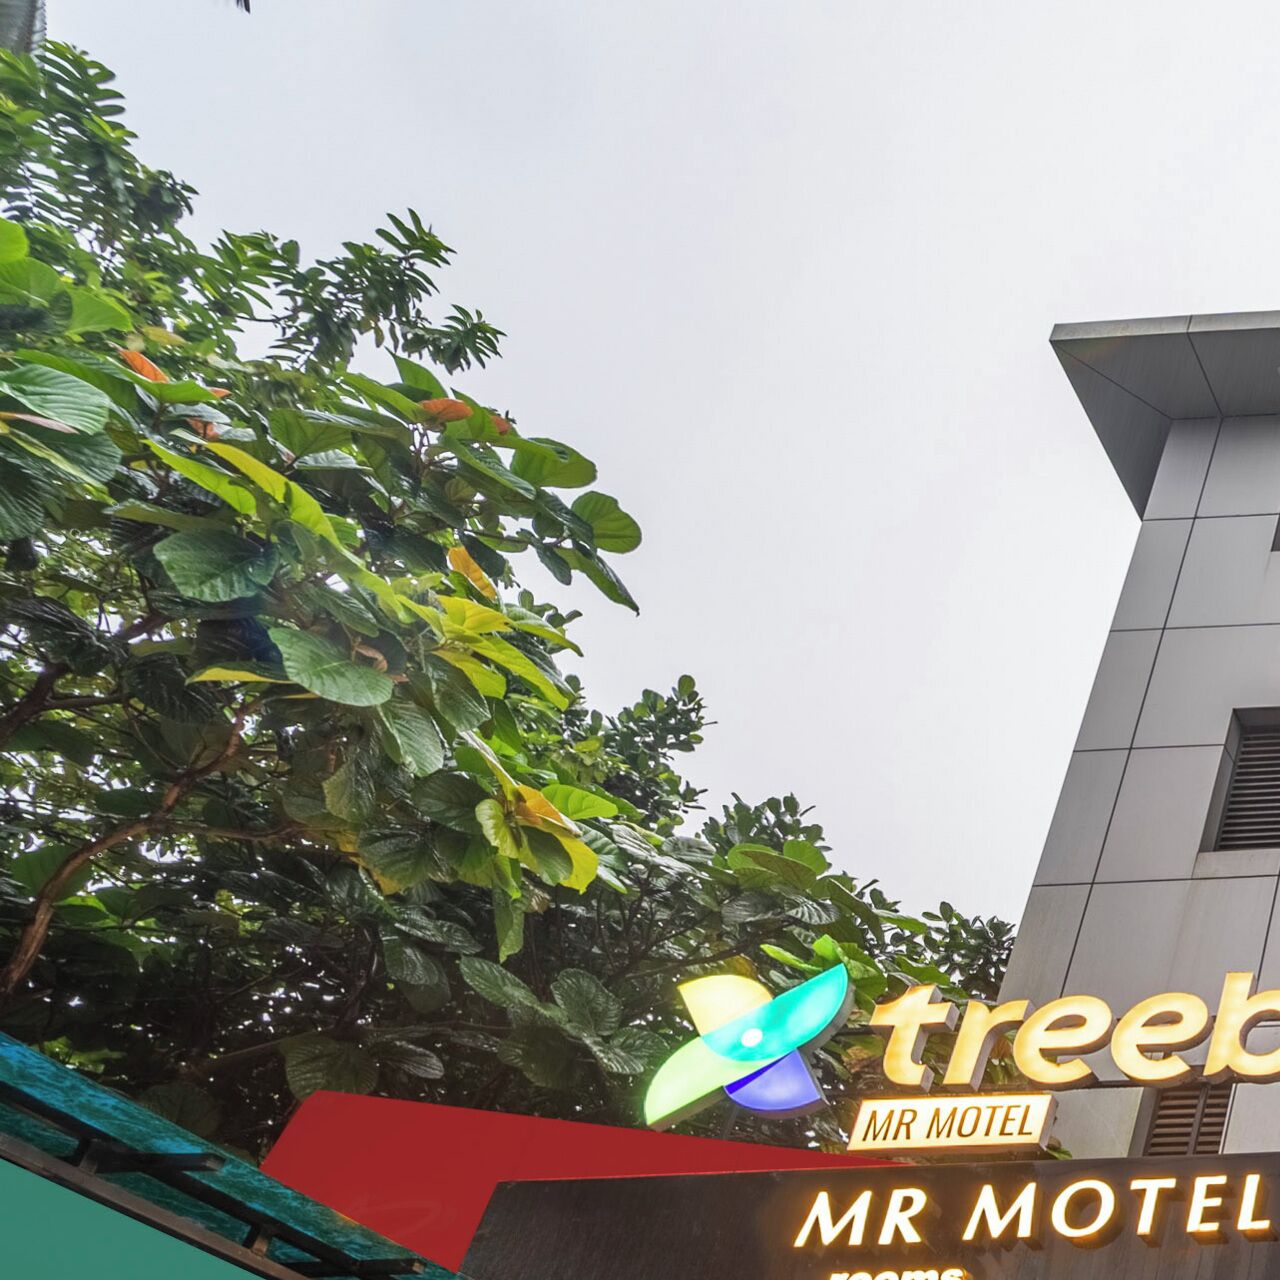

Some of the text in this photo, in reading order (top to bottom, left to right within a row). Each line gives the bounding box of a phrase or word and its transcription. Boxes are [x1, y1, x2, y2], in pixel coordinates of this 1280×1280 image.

[862, 1104, 1033, 1142] MR MOTEL
[794, 1174, 1271, 1247] MR MOTEL
